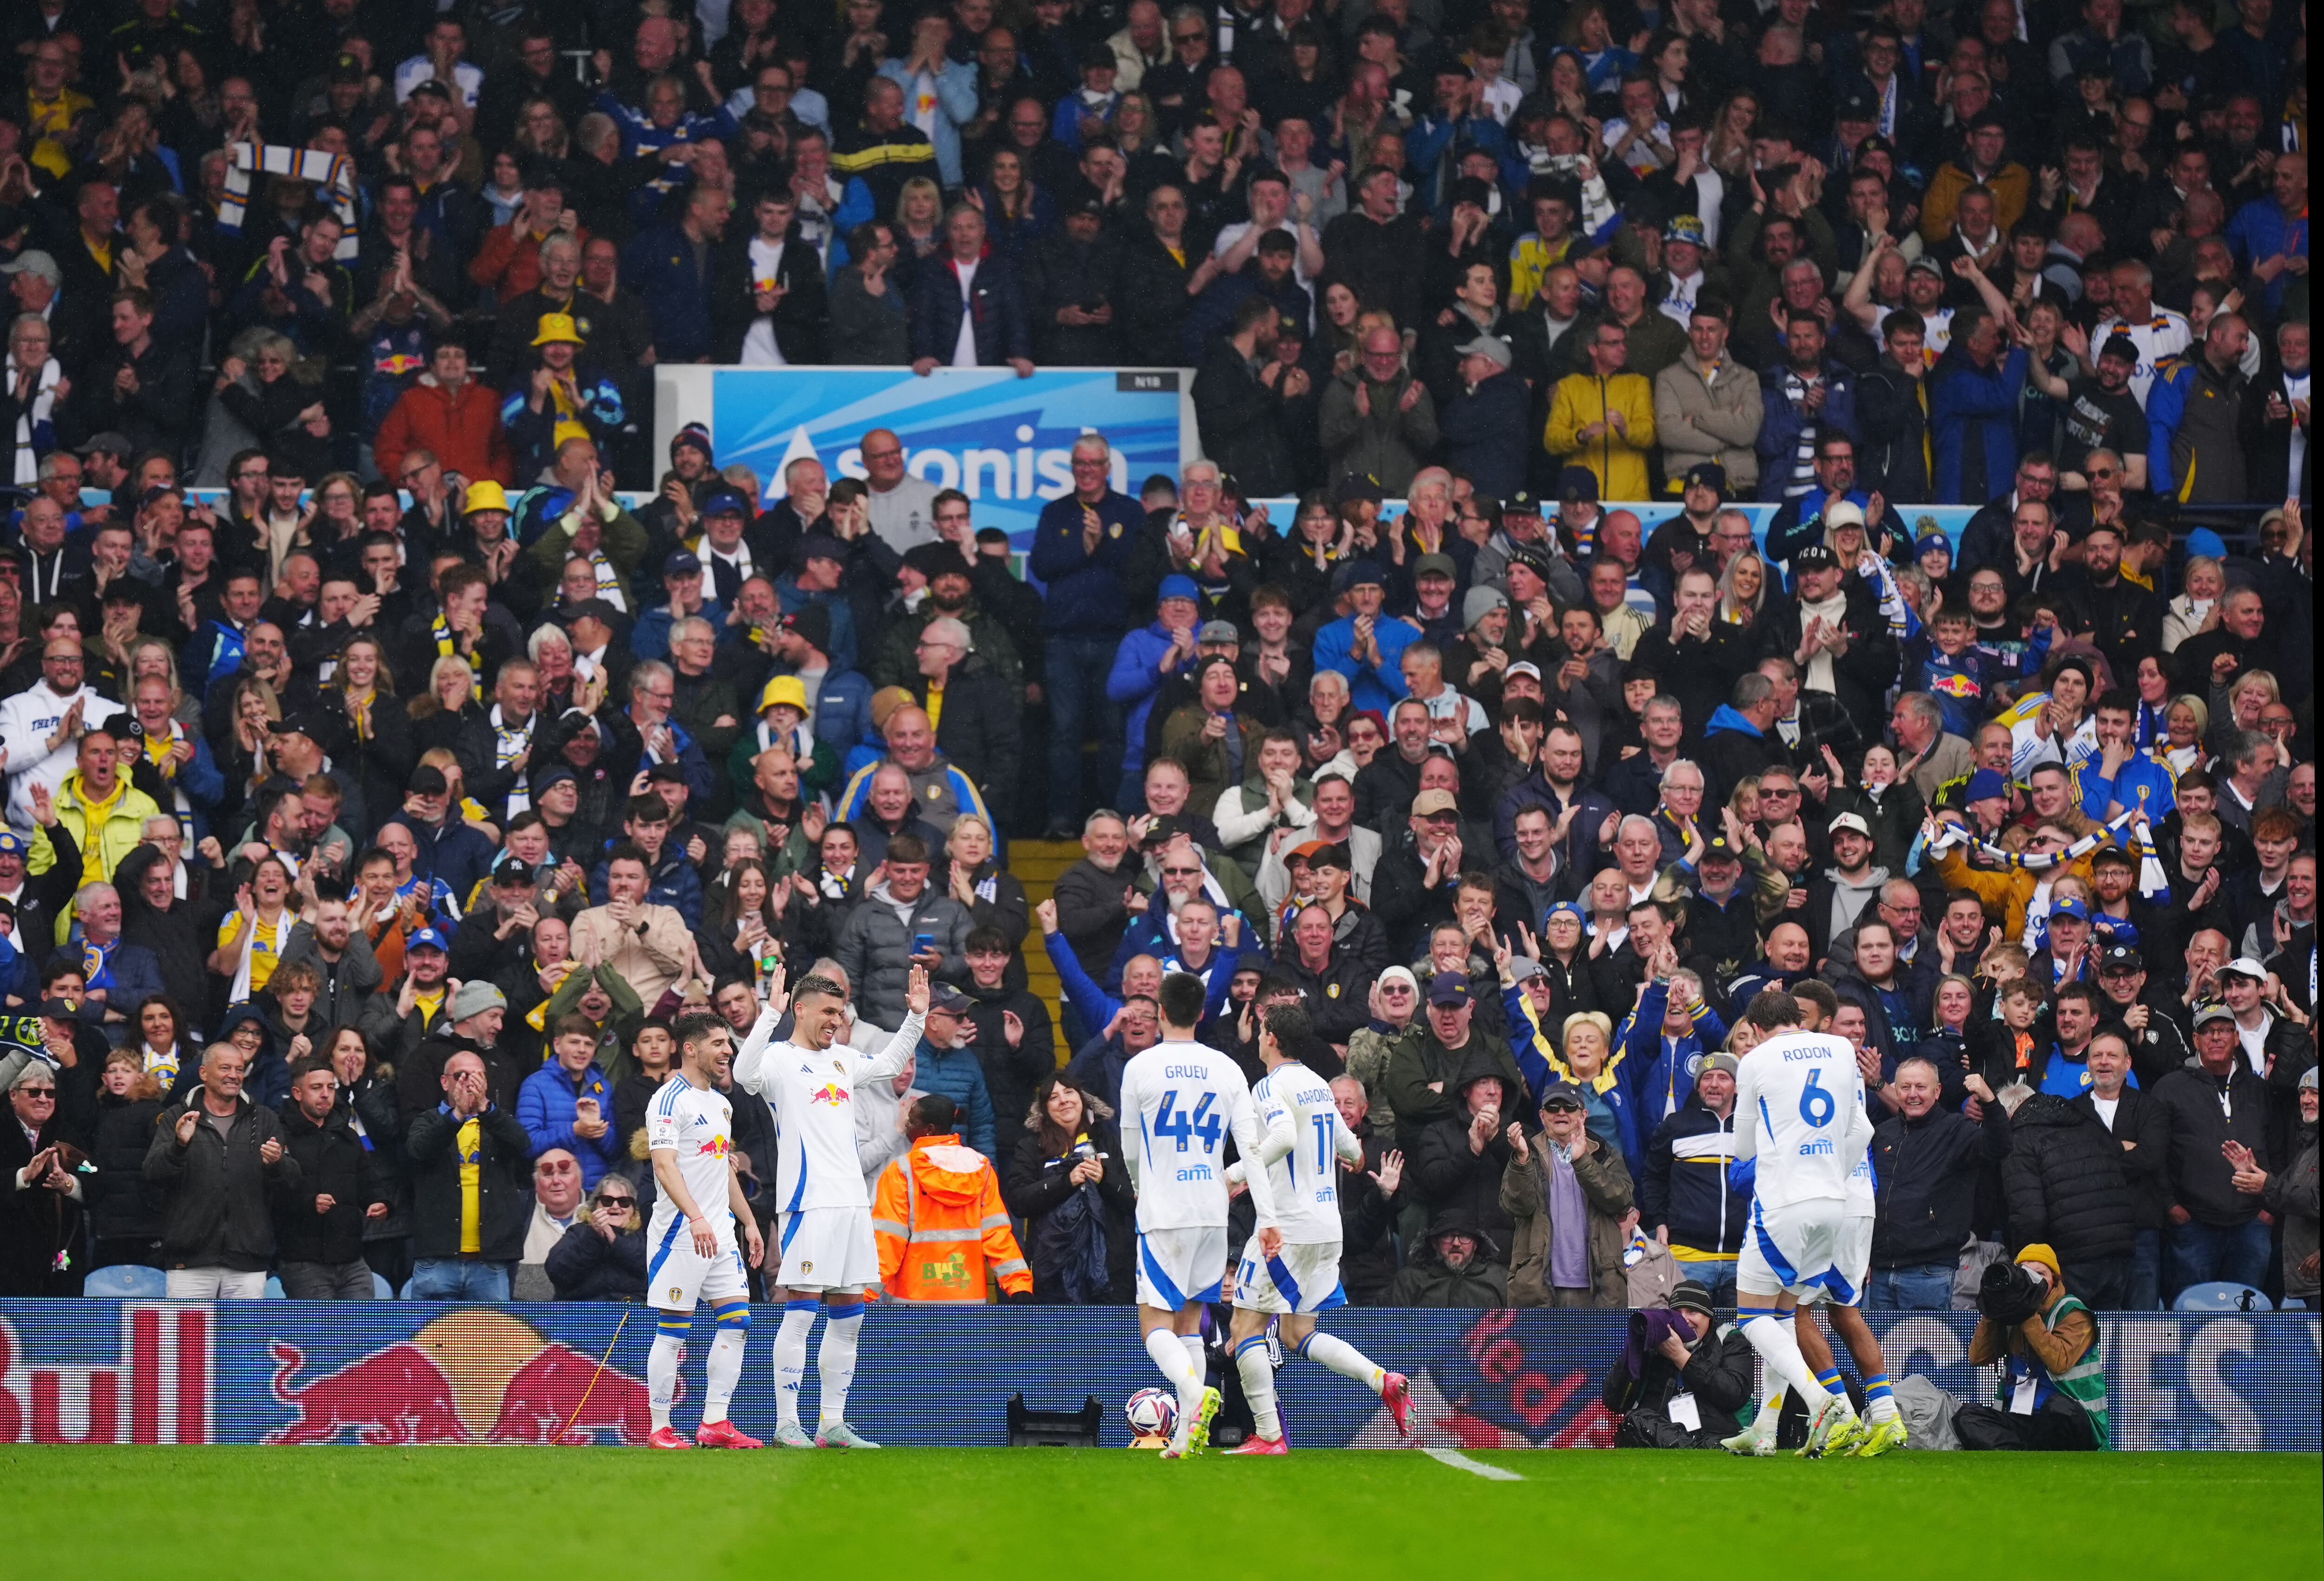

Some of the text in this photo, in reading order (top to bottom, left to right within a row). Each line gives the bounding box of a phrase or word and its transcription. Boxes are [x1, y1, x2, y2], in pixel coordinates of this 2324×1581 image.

[765, 423, 1128, 501] Asonish
[1798, 547, 1827, 560] ICON
[1783, 1047, 1832, 1062] RODON
[1165, 1065, 1208, 1080] GRUEV
[1296, 1088, 1334, 1106] AARONSO
[1799, 1068, 1835, 1128] 6
[1154, 1090, 1221, 1153] 44
[1312, 1113, 1334, 1175] 11
[1799, 1140, 1834, 1156] amt
[1176, 1166, 1213, 1181] amt
[922, 1262, 965, 1279] BWS
[0, 1303, 213, 1444] ull
